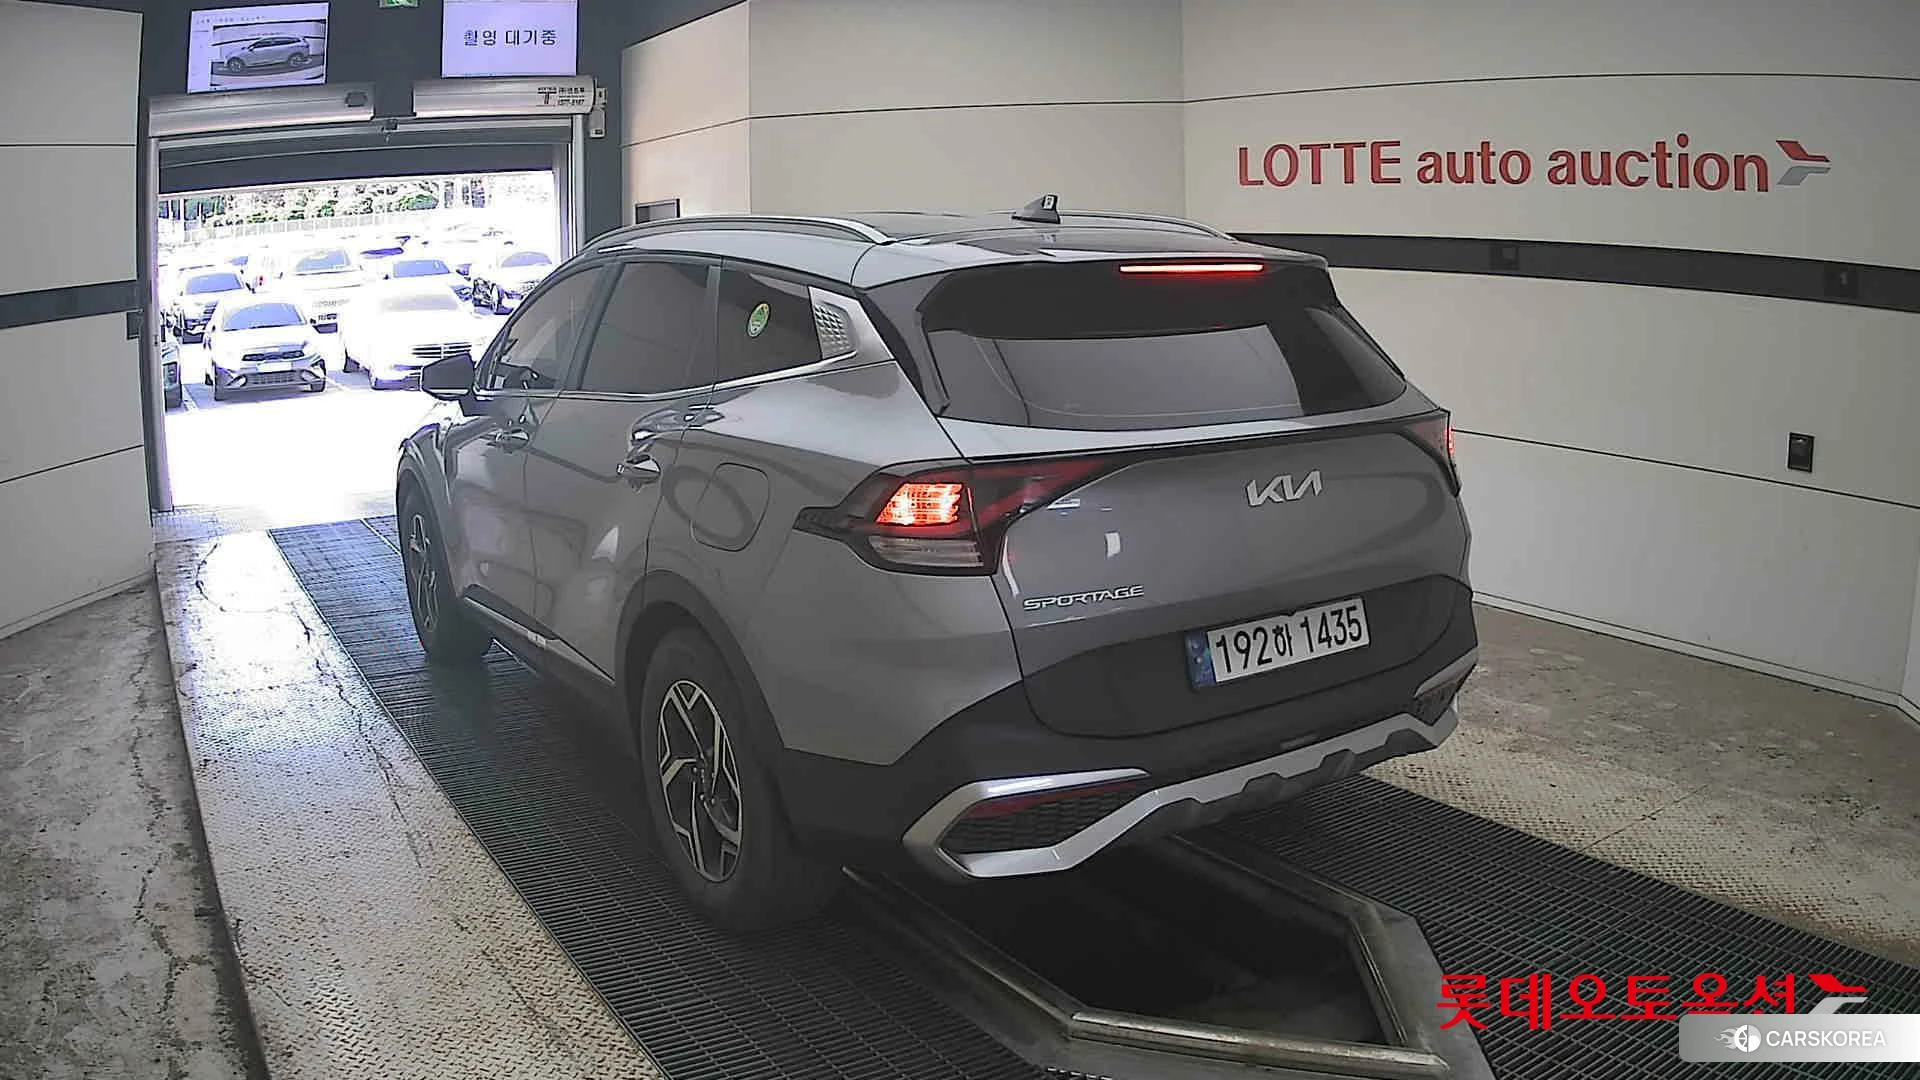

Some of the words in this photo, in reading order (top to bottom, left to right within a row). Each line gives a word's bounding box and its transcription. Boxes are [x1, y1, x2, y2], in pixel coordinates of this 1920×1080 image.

[505, 29, 557, 46] 대기중
[1238, 141, 1401, 187] LOTTE
[1416, 141, 1532, 185] auto
[1547, 133, 1769, 192] auction
[1023, 584, 1146, 611] SPORTAGE
[1215, 622, 1294, 674] 192하
[1299, 604, 1363, 653] 1435
